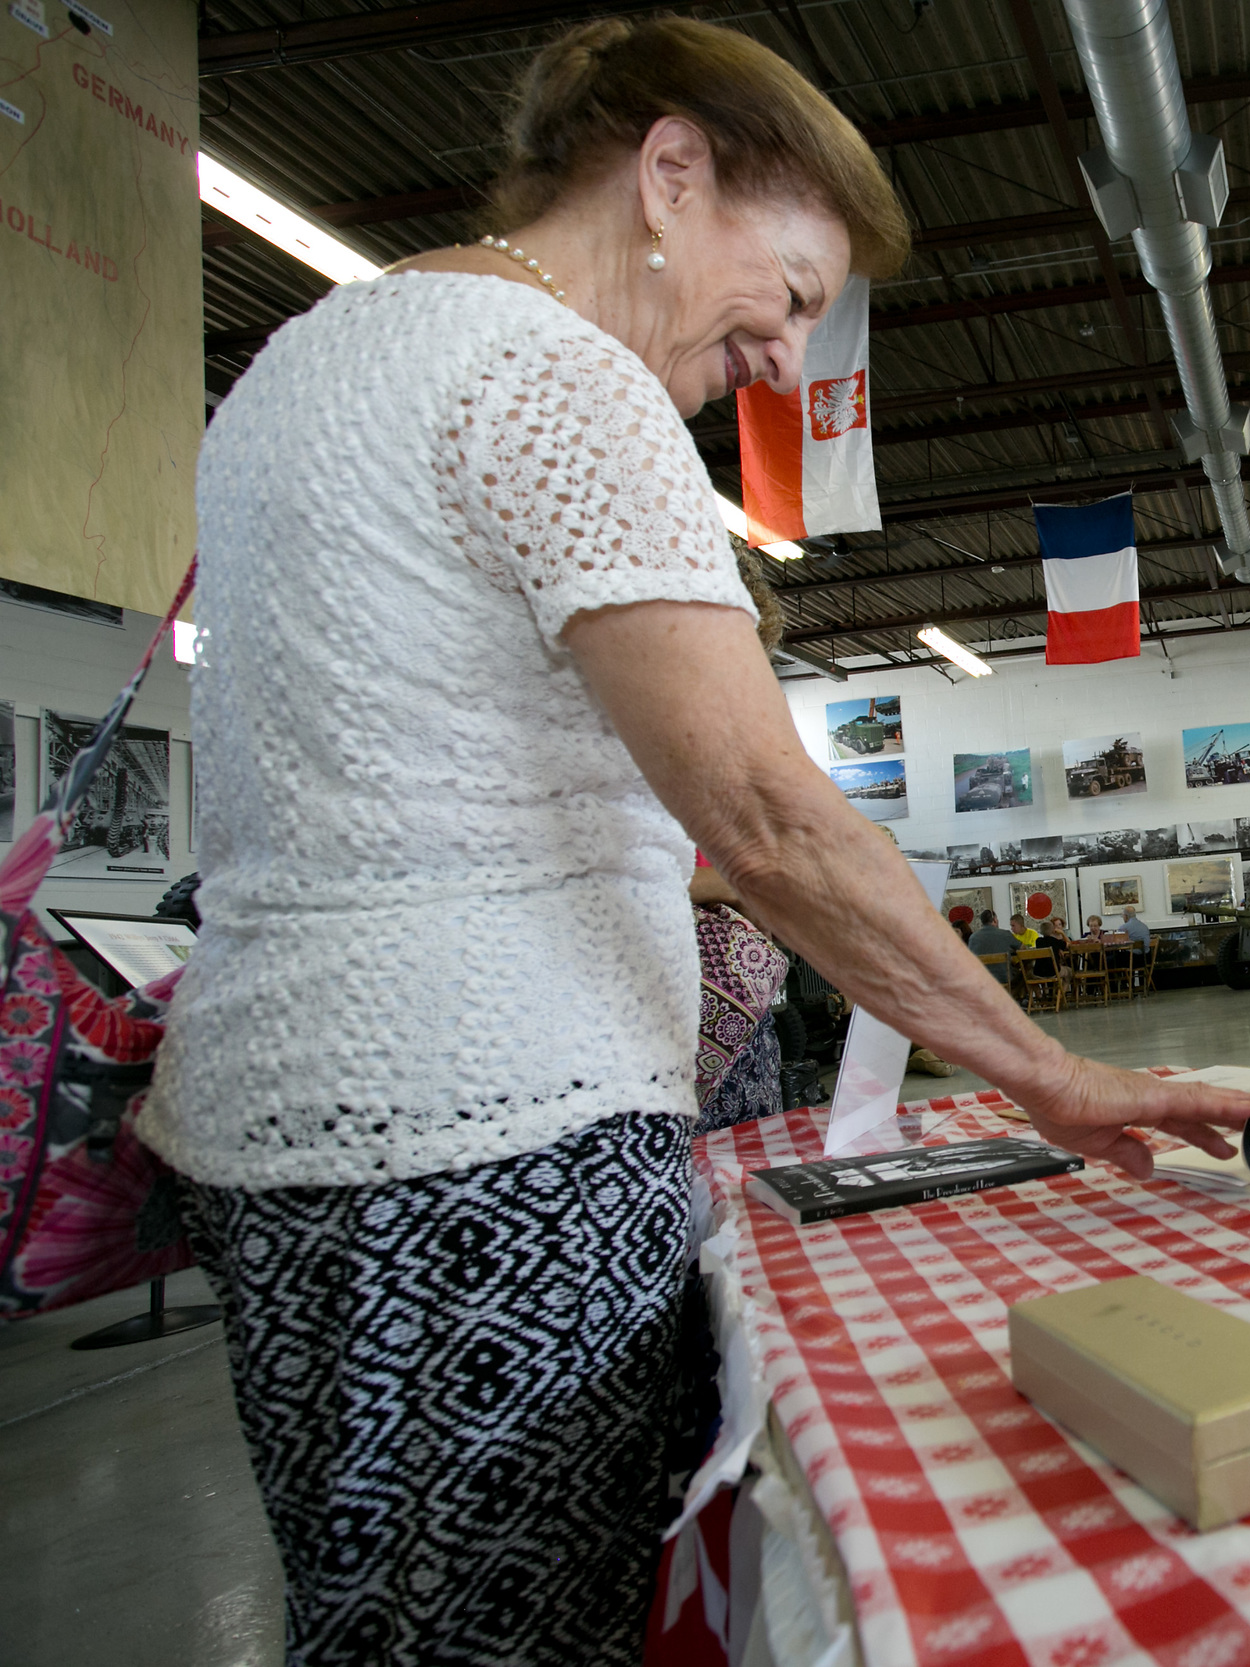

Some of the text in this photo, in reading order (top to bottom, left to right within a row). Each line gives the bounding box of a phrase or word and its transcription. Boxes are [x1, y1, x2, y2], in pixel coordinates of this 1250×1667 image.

[72, 63, 189, 155] GERMANY
[0, 199, 118, 282] OLLAND
[923, 1189, 935, 1200] The
[936, 1184, 971, 1197] Prevalence
[980, 1179, 995, 1189] Love
